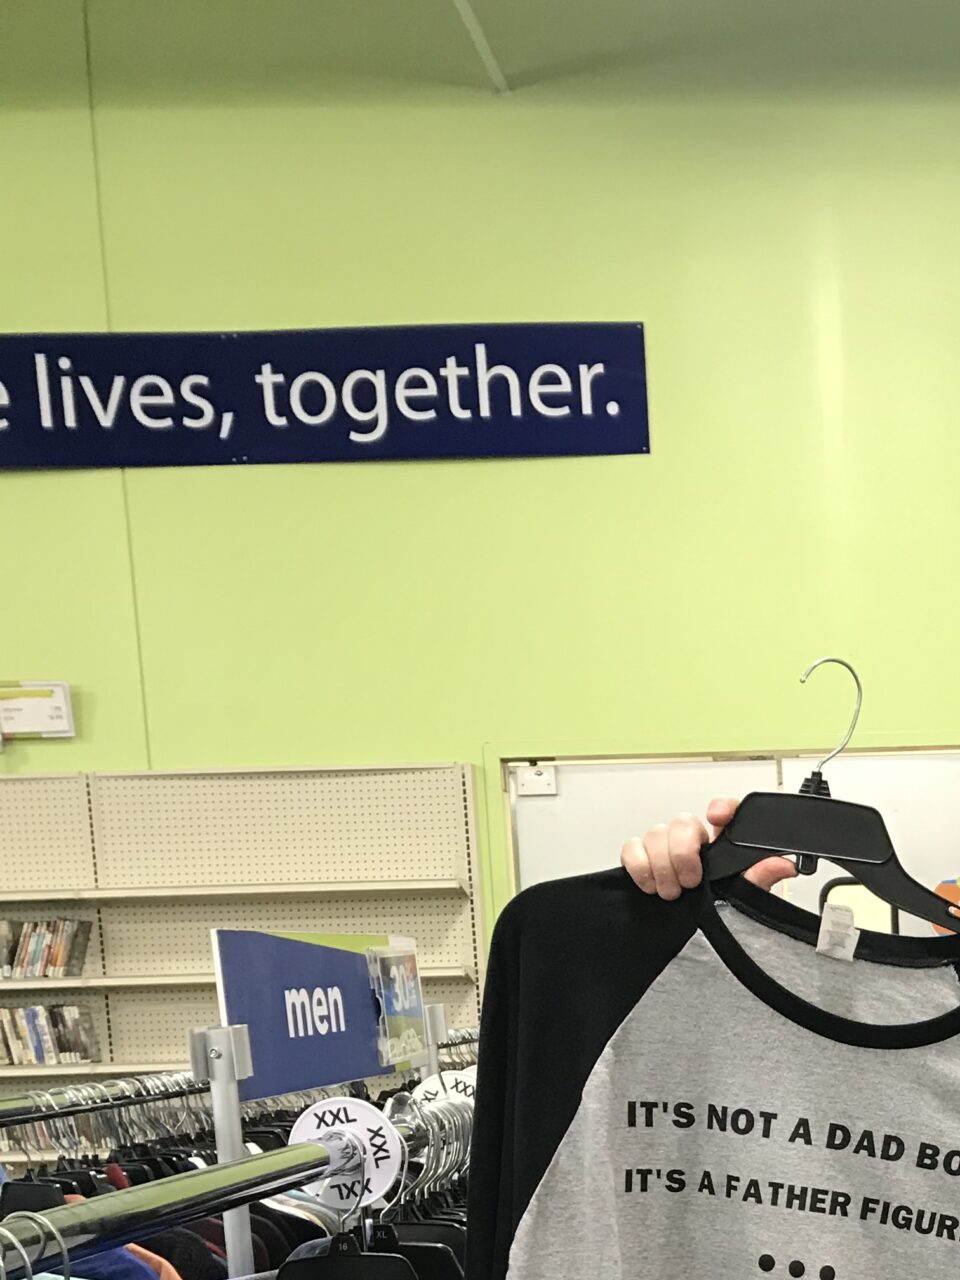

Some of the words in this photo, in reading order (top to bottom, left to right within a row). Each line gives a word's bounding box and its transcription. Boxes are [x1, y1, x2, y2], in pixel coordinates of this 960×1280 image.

[34, 352, 235, 440] lives,
[254, 343, 621, 443] together.
[284, 985, 346, 1038] men
[313, 1106, 357, 1130] XXL
[626, 1100, 696, 1129] IT'S
[706, 1103, 778, 1139] NOT
[788, 1117, 813, 1146] A
[825, 1122, 906, 1162] DAD
[366, 1126, 390, 1169] XXL
[330, 1178, 373, 1201] XXL
[624, 1167, 687, 1193] IT'S
[697, 1170, 716, 1196] A
[724, 1174, 852, 1218] FATHER
[376, 1230, 388, 1239] XL
